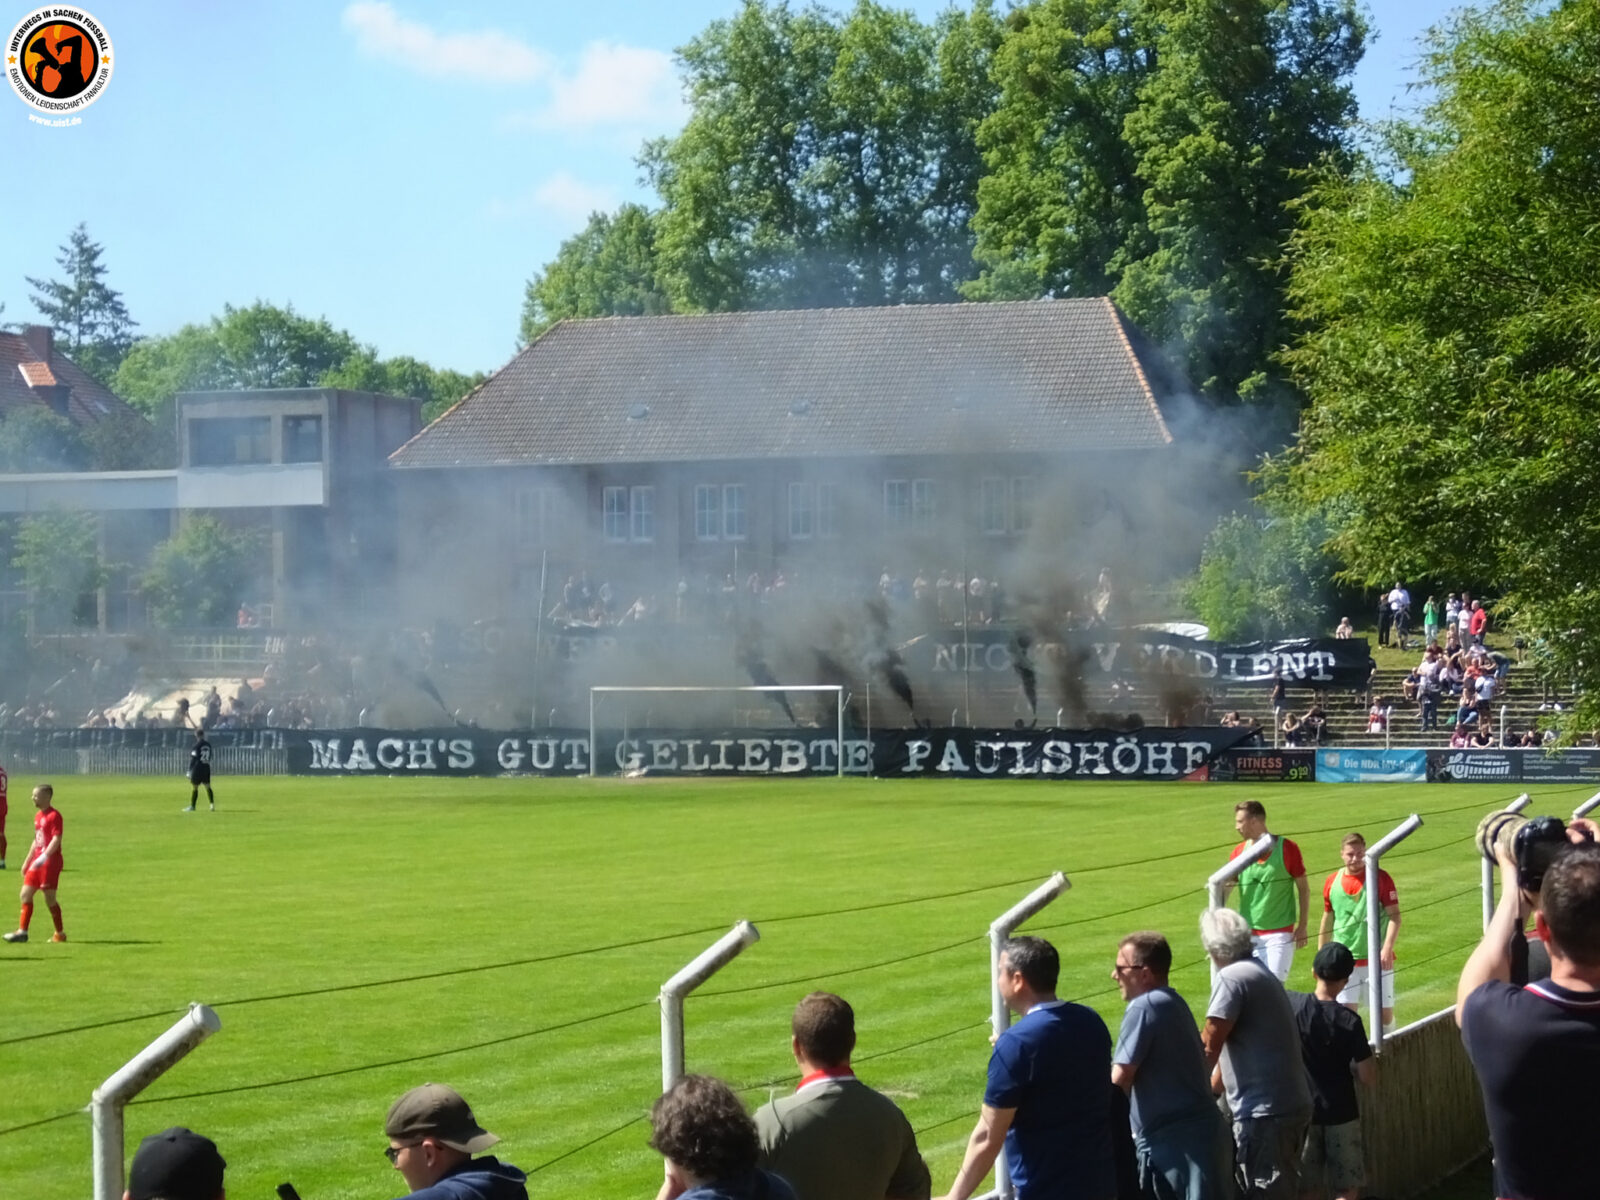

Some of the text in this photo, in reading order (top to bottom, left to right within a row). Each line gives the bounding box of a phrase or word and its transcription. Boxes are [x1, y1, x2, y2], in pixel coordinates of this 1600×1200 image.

[309, 738, 475, 770] MACH'S
[497, 738, 589, 771] GUT
[615, 739, 875, 773] GELIEBTE
[1236, 757, 1283, 769] FITNESS
[1344, 758, 1359, 769] Die
